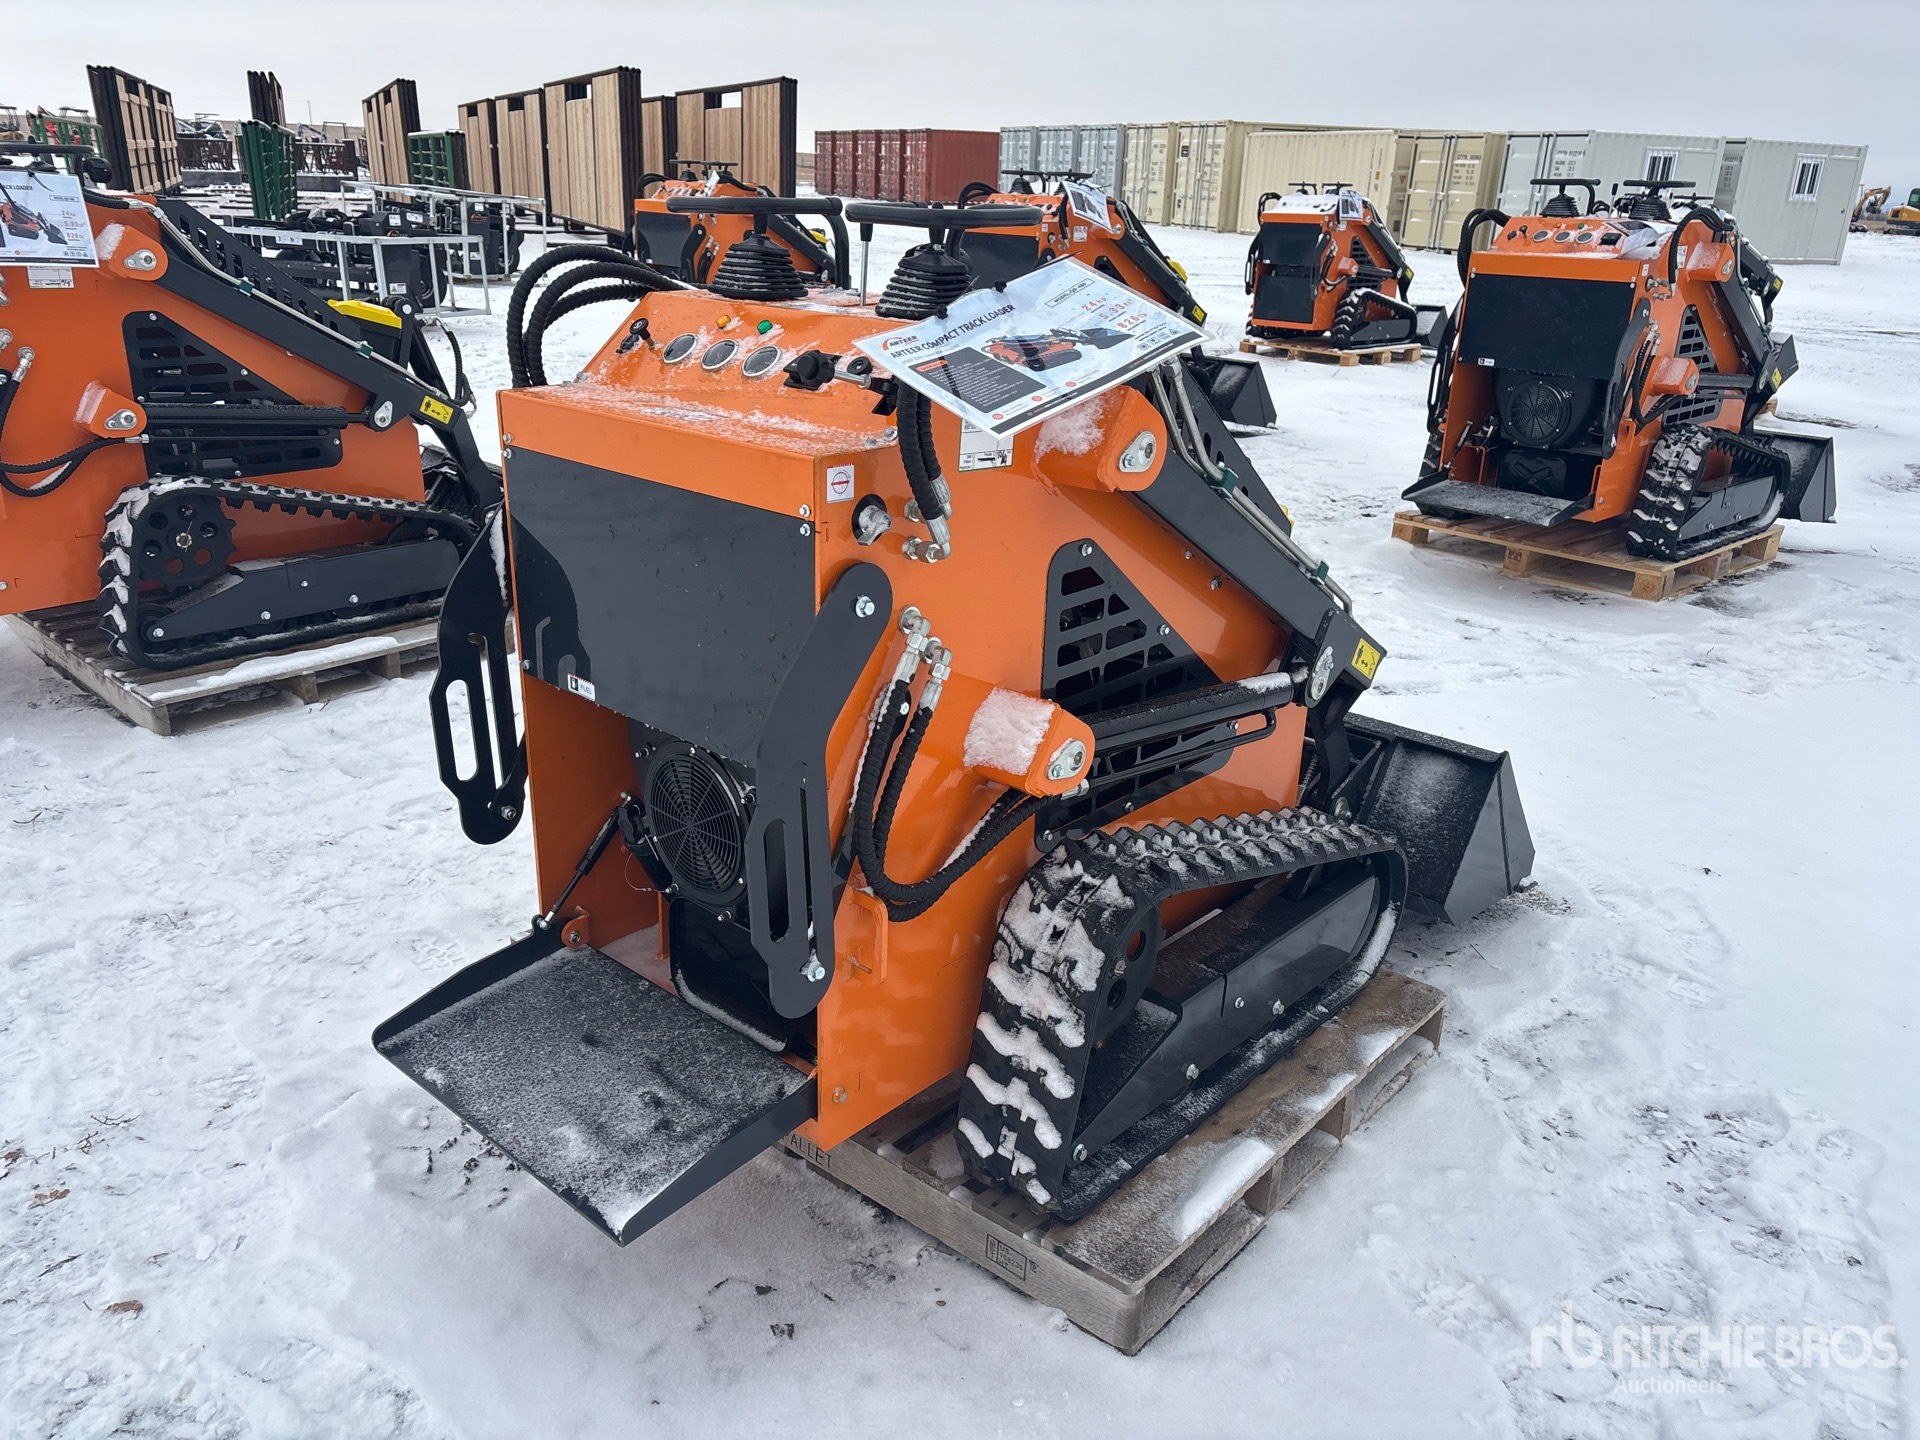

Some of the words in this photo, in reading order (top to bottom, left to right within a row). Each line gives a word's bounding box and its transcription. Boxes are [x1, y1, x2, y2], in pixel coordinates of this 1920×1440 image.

[889, 336, 918, 347] ARTEER
[890, 346, 922, 359] ARTEER
[921, 328, 960, 350] COMPACT
[958, 316, 987, 333] TRACK
[984, 304, 1016, 321] LOADER
[580, 684, 592, 695] FUEL
[782, 1134, 832, 1168] ALLET
